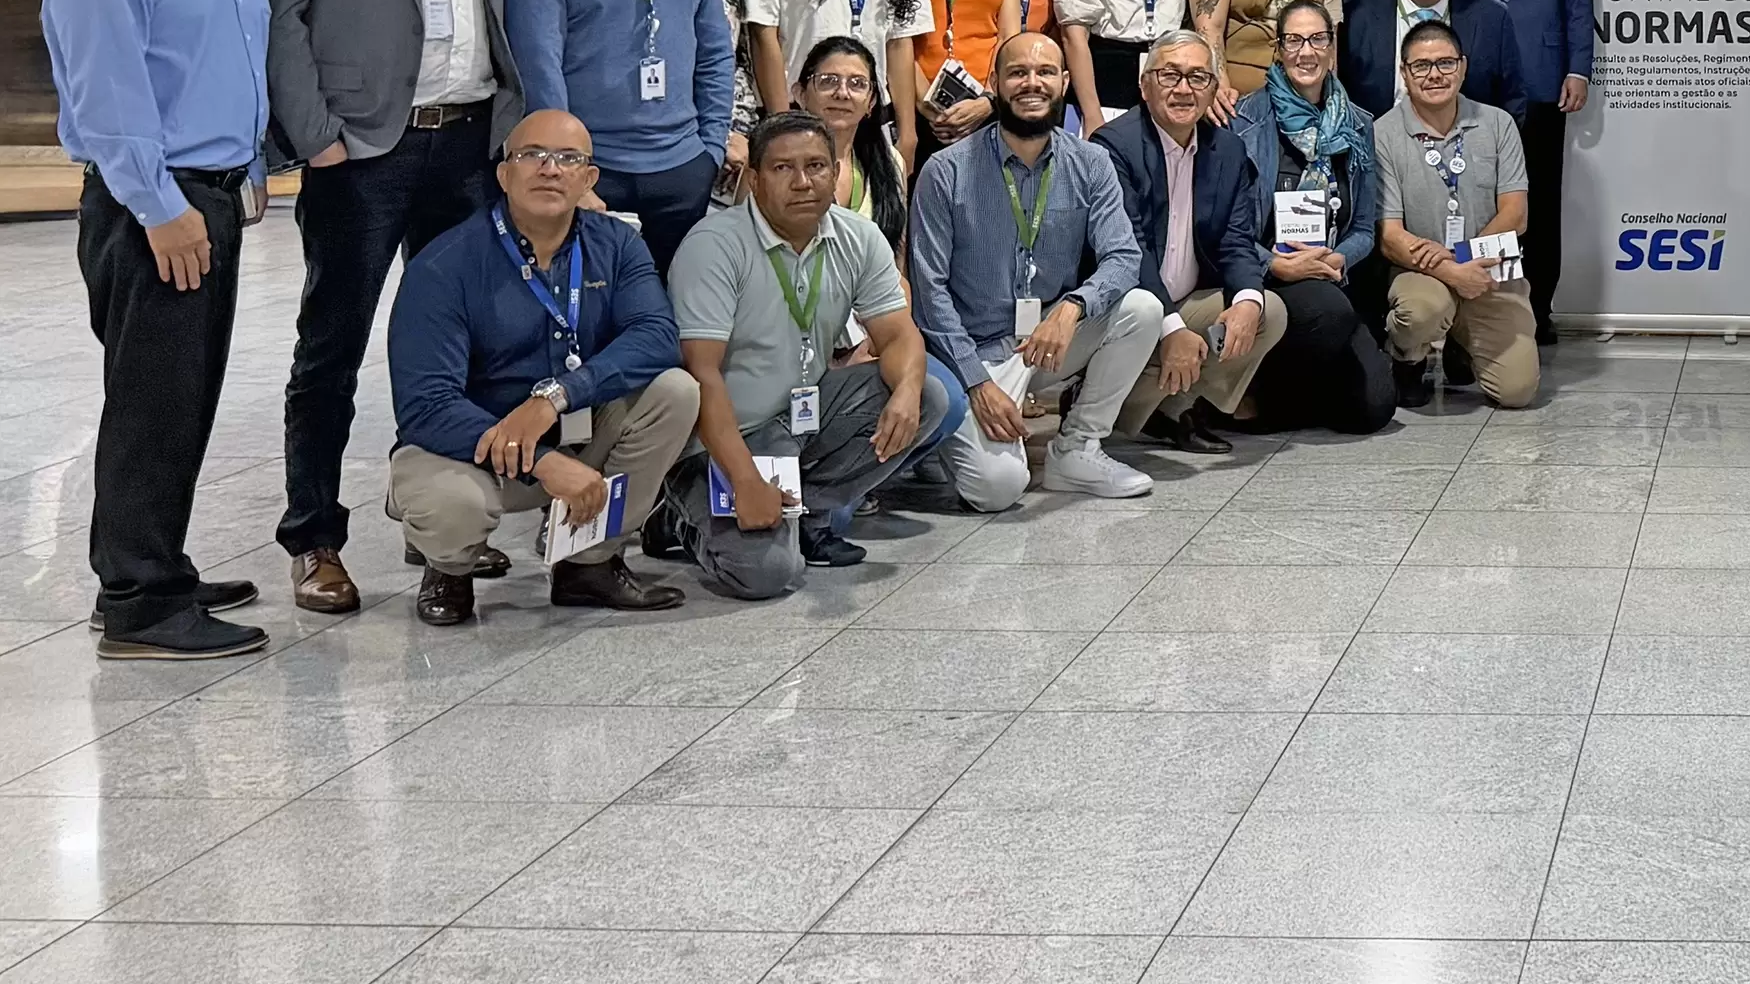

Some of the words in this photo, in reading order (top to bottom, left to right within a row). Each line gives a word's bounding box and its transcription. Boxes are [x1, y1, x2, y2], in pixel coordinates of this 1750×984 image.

[1592, 54, 1626, 63] onsulte
[1628, 55, 1640, 63] as
[1642, 54, 1701, 65] Resoluções,
[1591, 66, 1624, 76] nterno,
[1626, 66, 1701, 76] Regulamentos,
[1588, 78, 1645, 86] Normativas
[1655, 77, 1692, 86] demais
[1694, 78, 1716, 86] atos
[1604, 90, 1622, 99] que
[1625, 89, 1671, 97] orientam
[1681, 89, 1715, 99] gestão
[1609, 100, 1661, 109] atividades
[1663, 100, 1732, 109] institucionais.
[1621, 213, 1673, 224] Conselho
[1676, 213, 1727, 224] Nacional
